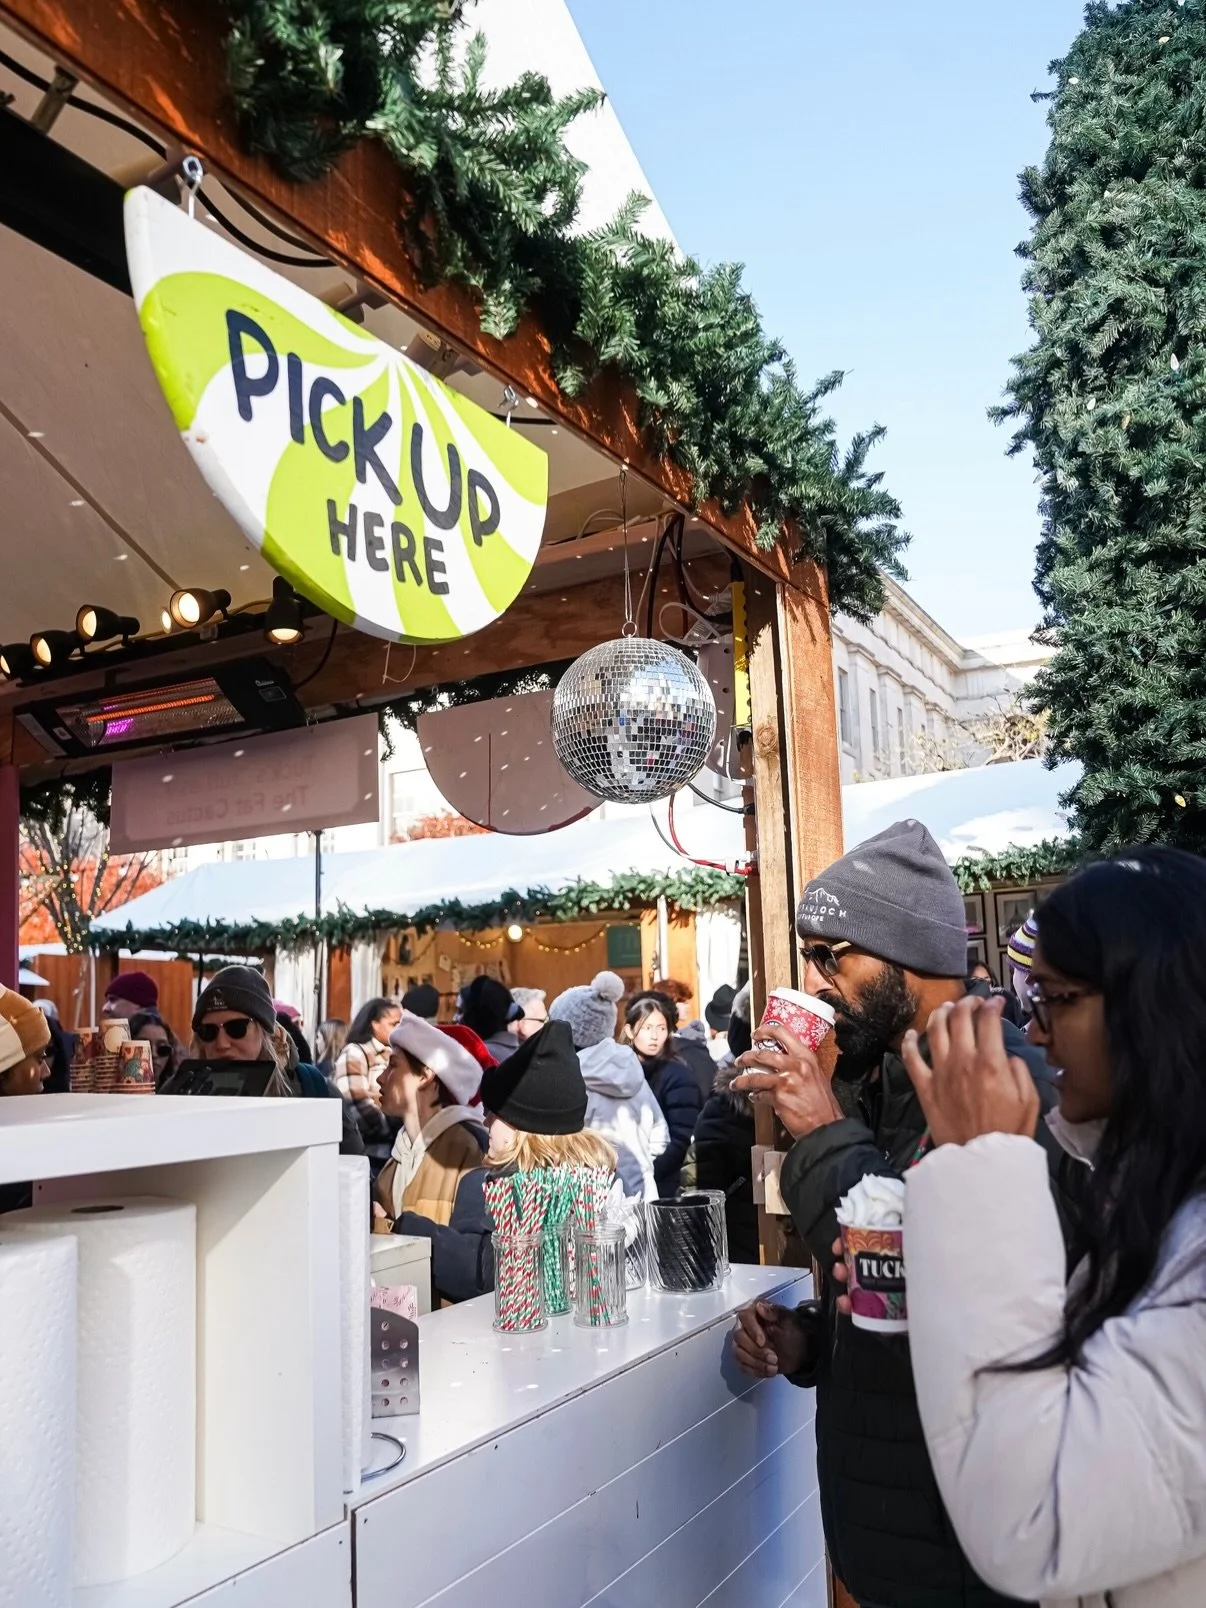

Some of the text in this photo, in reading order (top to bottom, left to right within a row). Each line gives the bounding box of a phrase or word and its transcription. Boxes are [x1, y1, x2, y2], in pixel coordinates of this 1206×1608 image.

[226, 309, 501, 547] PICK UP
[327, 498, 450, 595] HERE
